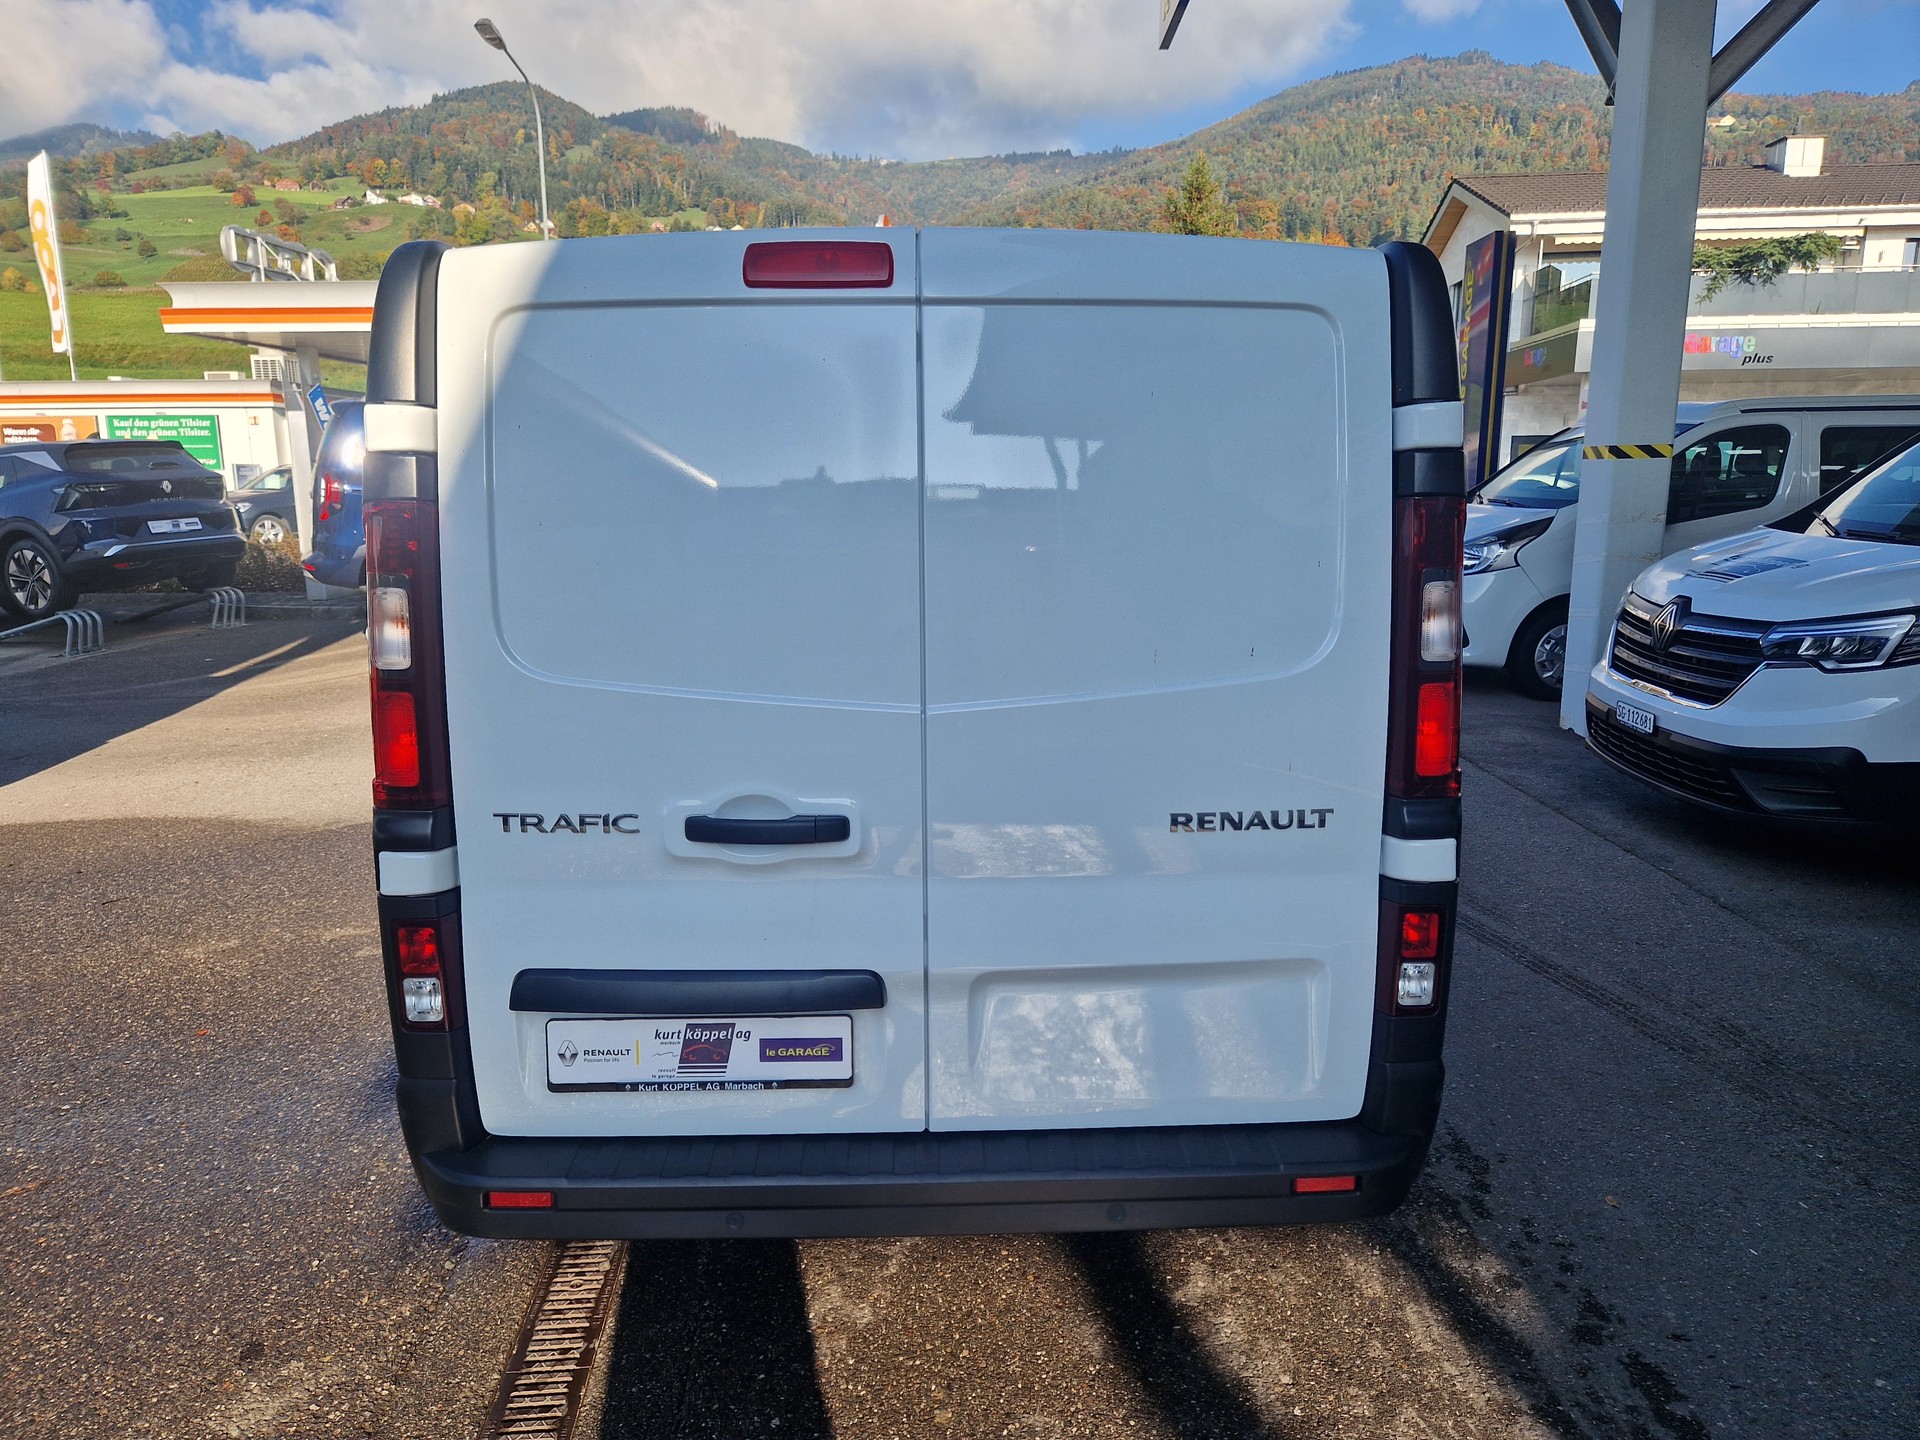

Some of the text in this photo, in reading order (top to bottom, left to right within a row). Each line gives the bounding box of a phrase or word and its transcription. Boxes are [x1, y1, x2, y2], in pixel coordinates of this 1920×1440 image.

[1460, 269, 1474, 381] GARAGE
[1685, 333, 1756, 358] Garage
[1741, 352, 1774, 366] plus
[112, 418, 211, 429] Kauf den grünen Tilsiter
[115, 428, 131, 437] und
[132, 428, 147, 437] den
[493, 812, 641, 834] TRAFIC
[1169, 808, 1335, 833] RENAULT
[654, 1027, 752, 1042] kurt köppel ag
[583, 1048, 632, 1057] RENAULT
[766, 1047, 830, 1057] le GARAGE
[638, 1083, 659, 1092] Kurt
[705, 1082, 720, 1091] AG
[724, 1082, 764, 1091] Marbach
